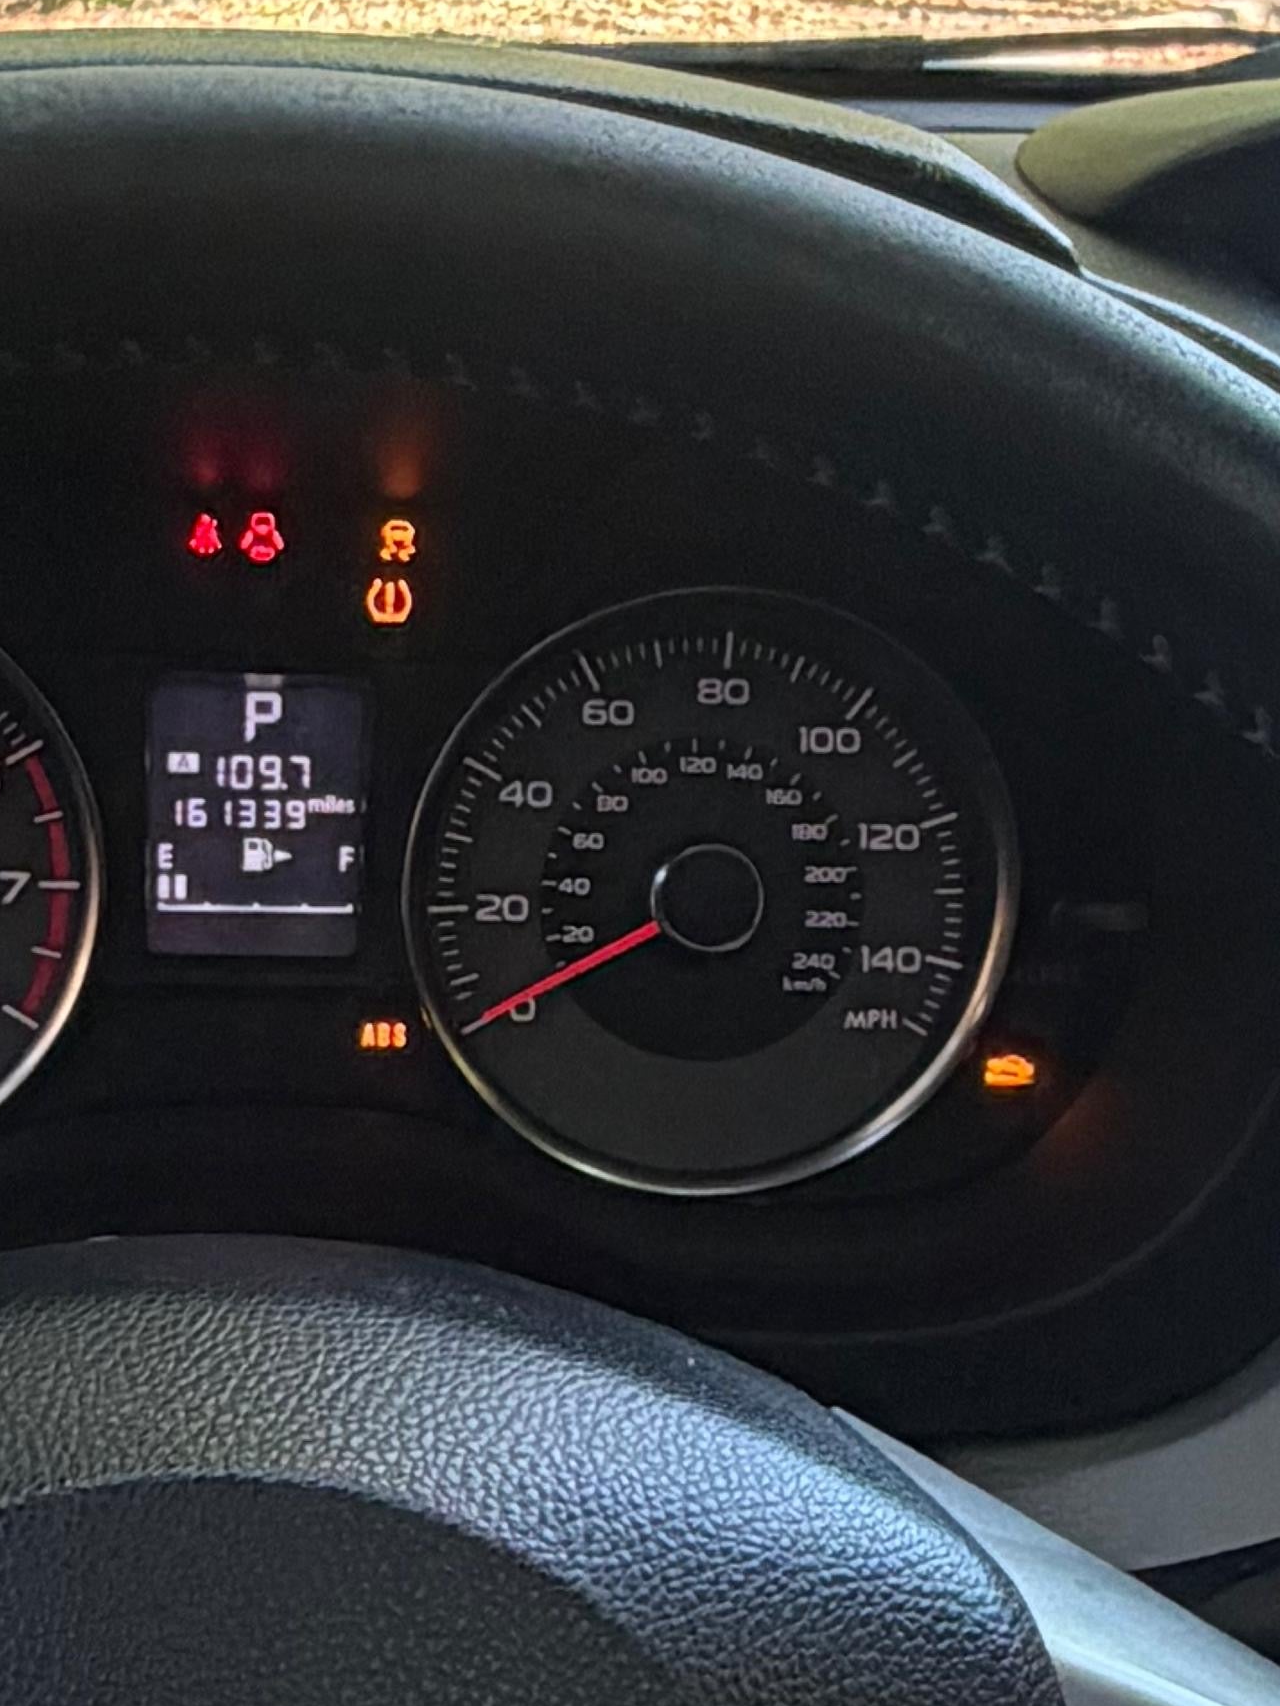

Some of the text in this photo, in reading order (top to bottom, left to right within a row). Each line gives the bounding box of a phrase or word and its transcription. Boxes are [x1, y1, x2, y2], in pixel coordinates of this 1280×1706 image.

[697, 678, 750, 705] 80
[244, 691, 283, 743] P
[582, 699, 634, 726] 60
[799, 727, 861, 755] 100
[216, 754, 312, 791] 109.7
[631, 767, 668, 784] 100
[679, 756, 717, 774] 120
[726, 763, 763, 781] 140
[306, 794, 356, 815] miles
[499, 781, 553, 809] 40
[596, 795, 628, 813] 80
[765, 789, 802, 805] 160
[572, 832, 605, 850] 60
[791, 823, 828, 841] 180
[858, 823, 920, 851] 120
[157, 843, 356, 873] E F
[803, 866, 846, 884] 200
[558, 877, 591, 895] 40
[475, 894, 529, 922] 20
[804, 910, 847, 928] 220
[562, 925, 595, 944] 20
[791, 952, 836, 970] 240
[860, 945, 922, 974] 140
[844, 1009, 898, 1031] MPH
[360, 1021, 408, 1048] ABS
